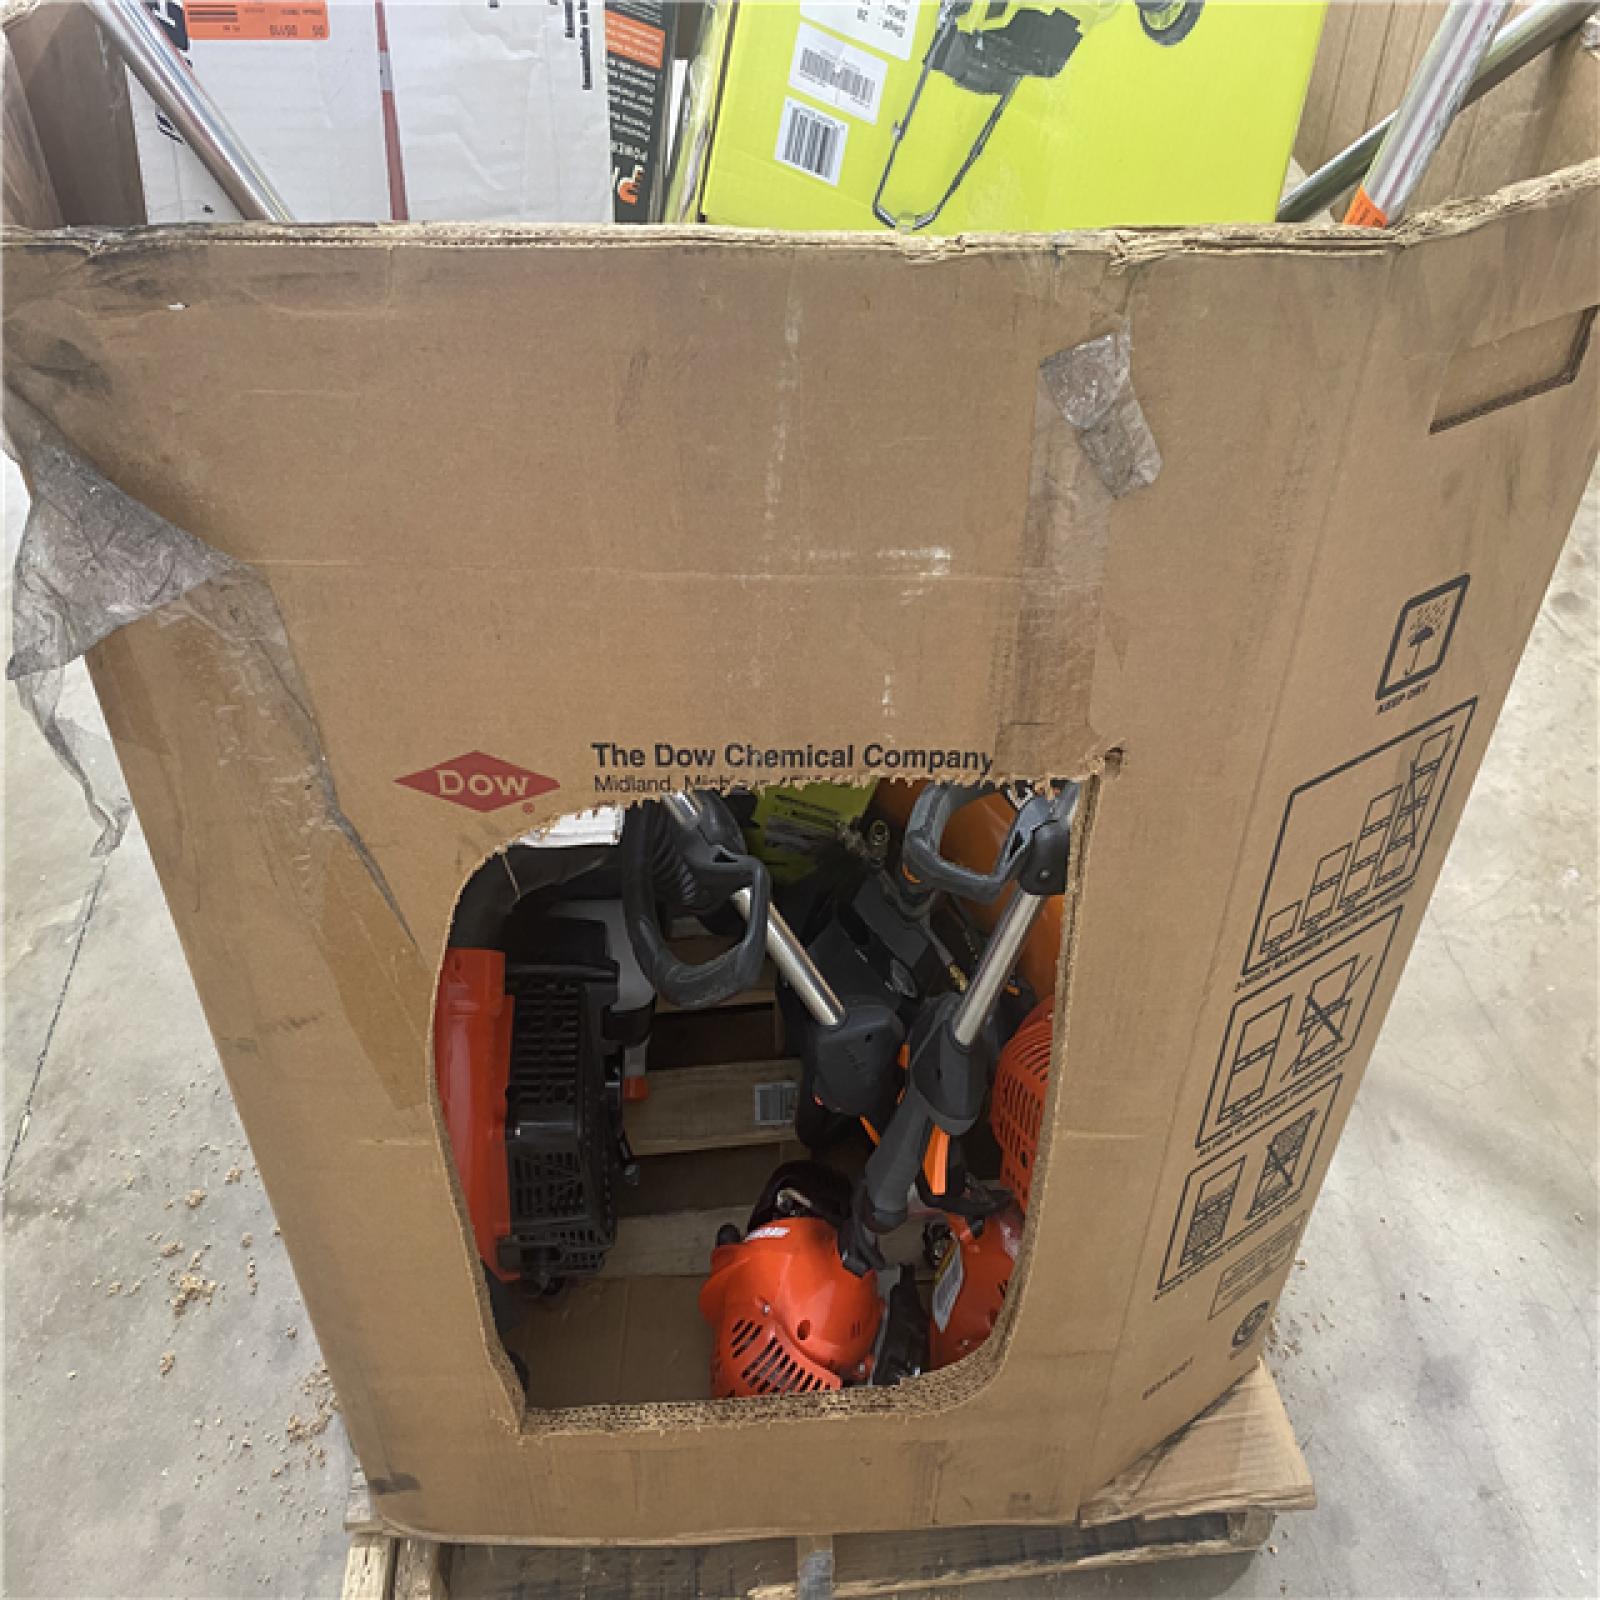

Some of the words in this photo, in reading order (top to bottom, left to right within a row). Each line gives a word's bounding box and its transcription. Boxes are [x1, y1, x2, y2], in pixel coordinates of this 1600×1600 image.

[592, 742, 645, 768] The
[655, 743, 716, 768] Dow
[725, 743, 853, 768] Chemical
[863, 743, 993, 774] Company
